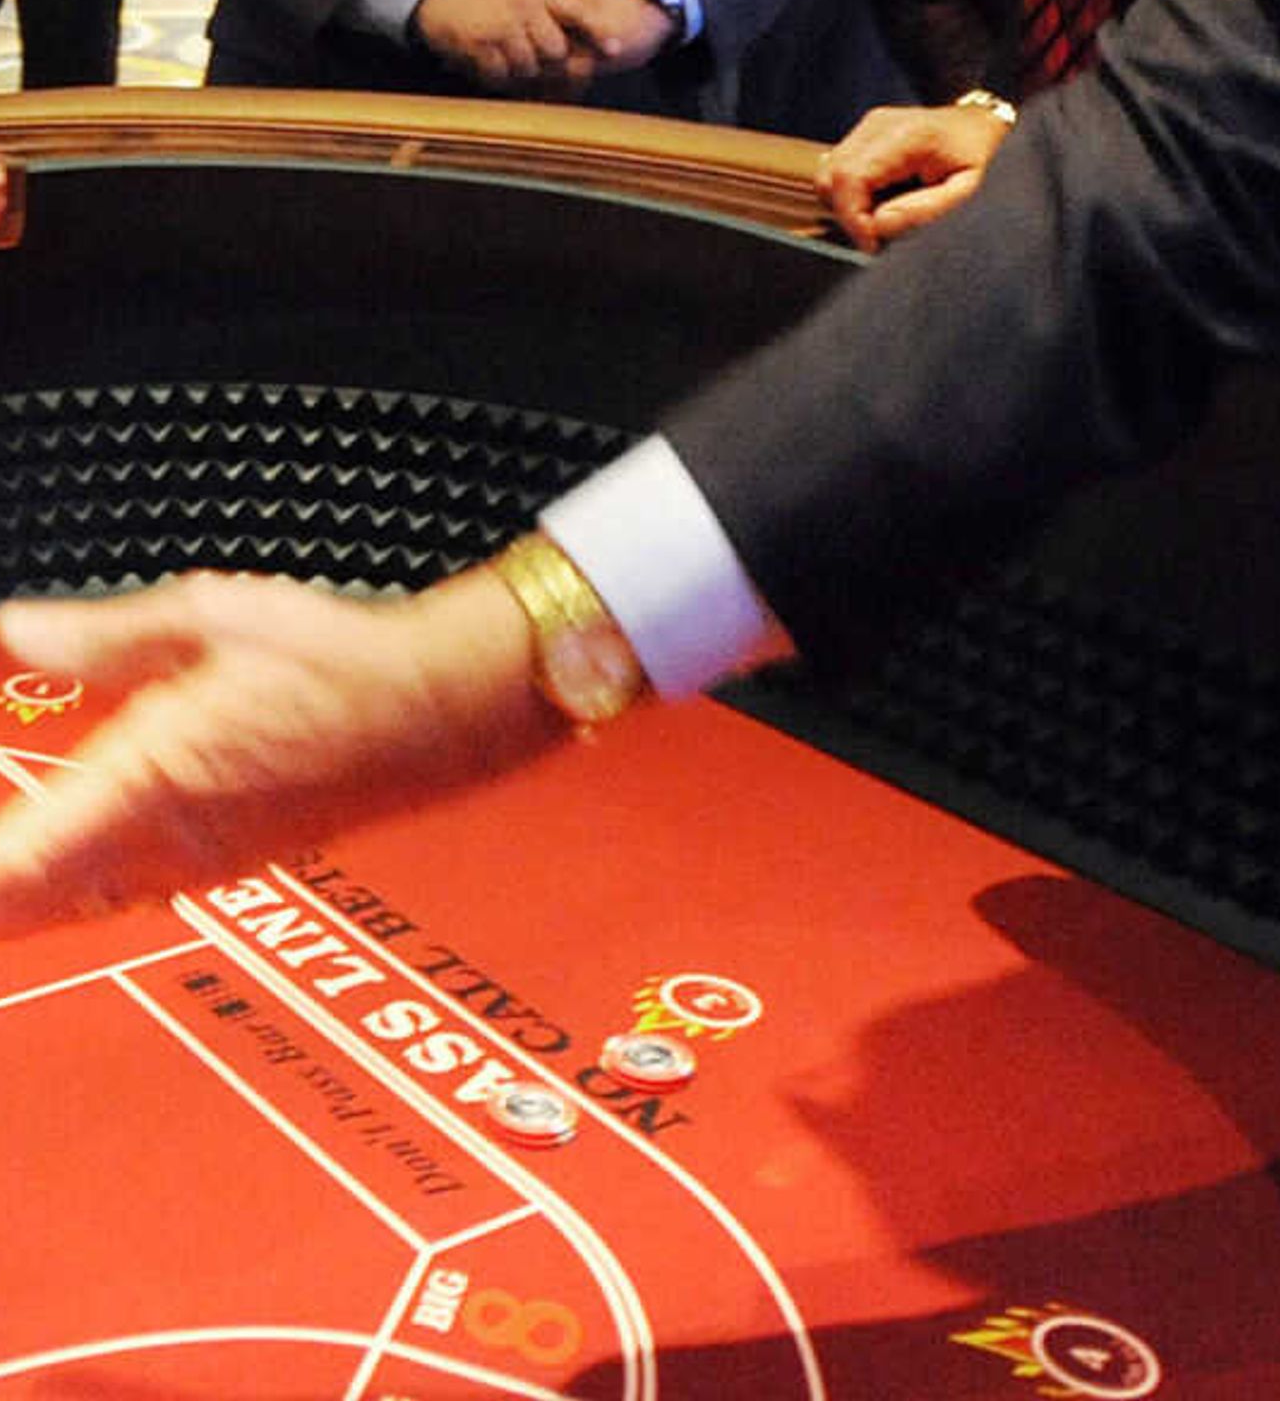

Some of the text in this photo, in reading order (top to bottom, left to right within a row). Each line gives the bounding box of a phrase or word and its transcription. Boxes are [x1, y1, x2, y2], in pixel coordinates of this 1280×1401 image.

[206, 877, 517, 1102] ASS LINE
[418, 945, 571, 1054] CALL
[299, 1065, 375, 1123] Pass
[410, 1268, 469, 1334] BIG
[463, 1288, 583, 1365] 8
